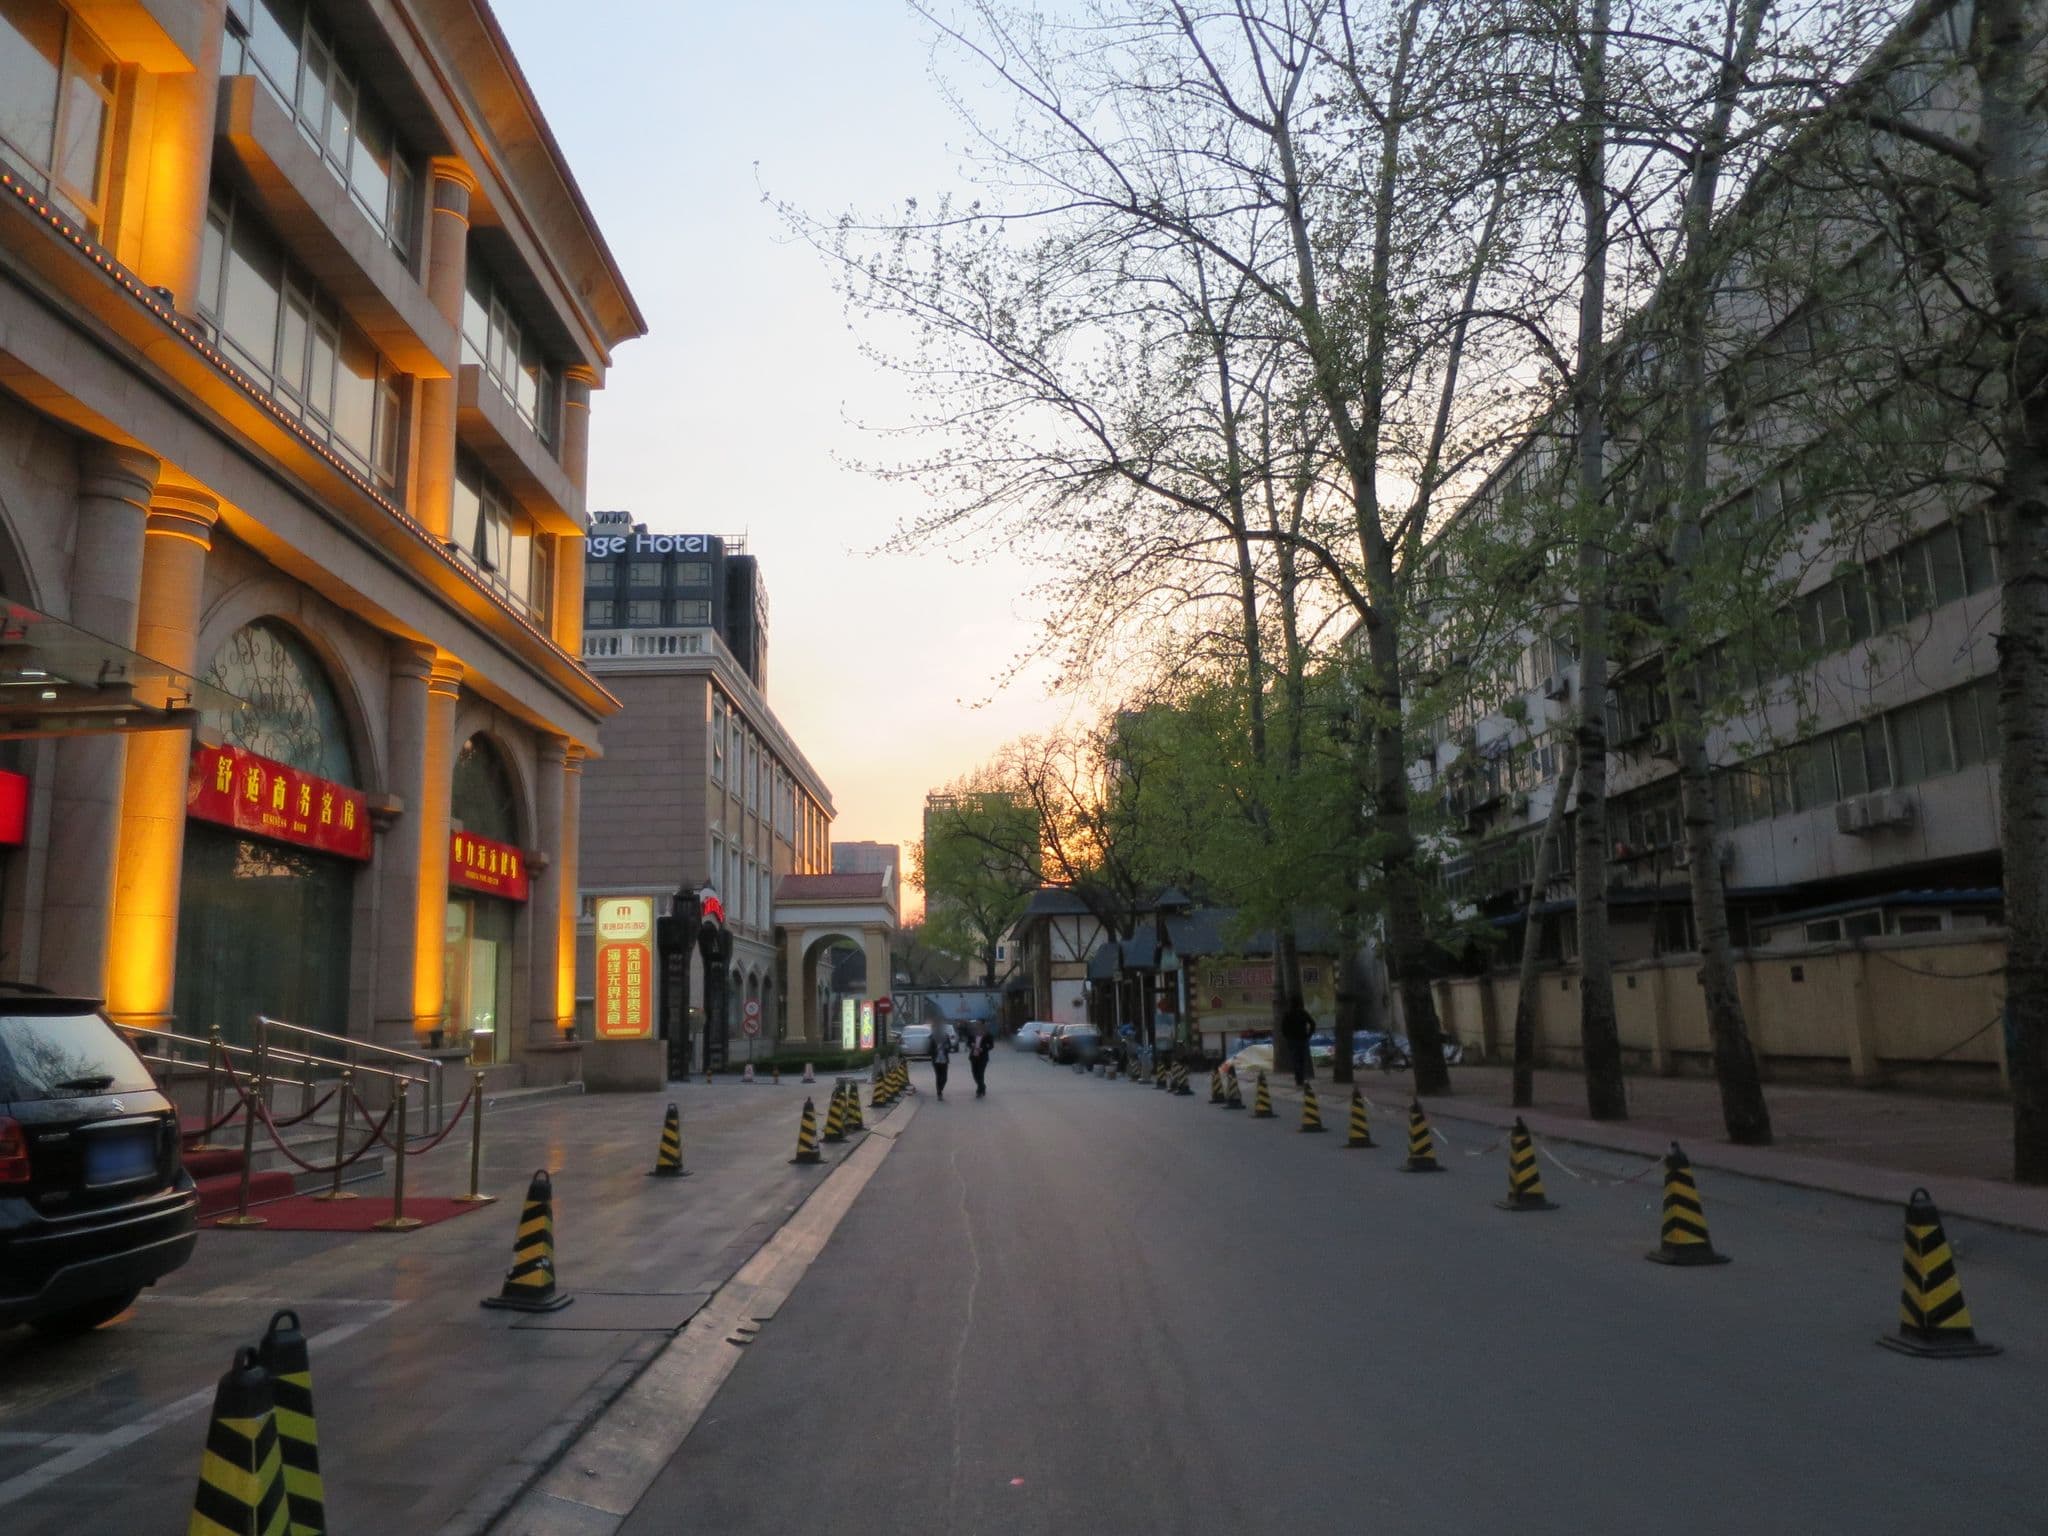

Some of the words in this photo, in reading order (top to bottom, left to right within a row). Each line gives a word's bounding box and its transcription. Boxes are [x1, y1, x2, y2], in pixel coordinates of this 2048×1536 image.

[636, 534, 708, 553] Hotel
[216, 755, 354, 830] 舒适商务客房
